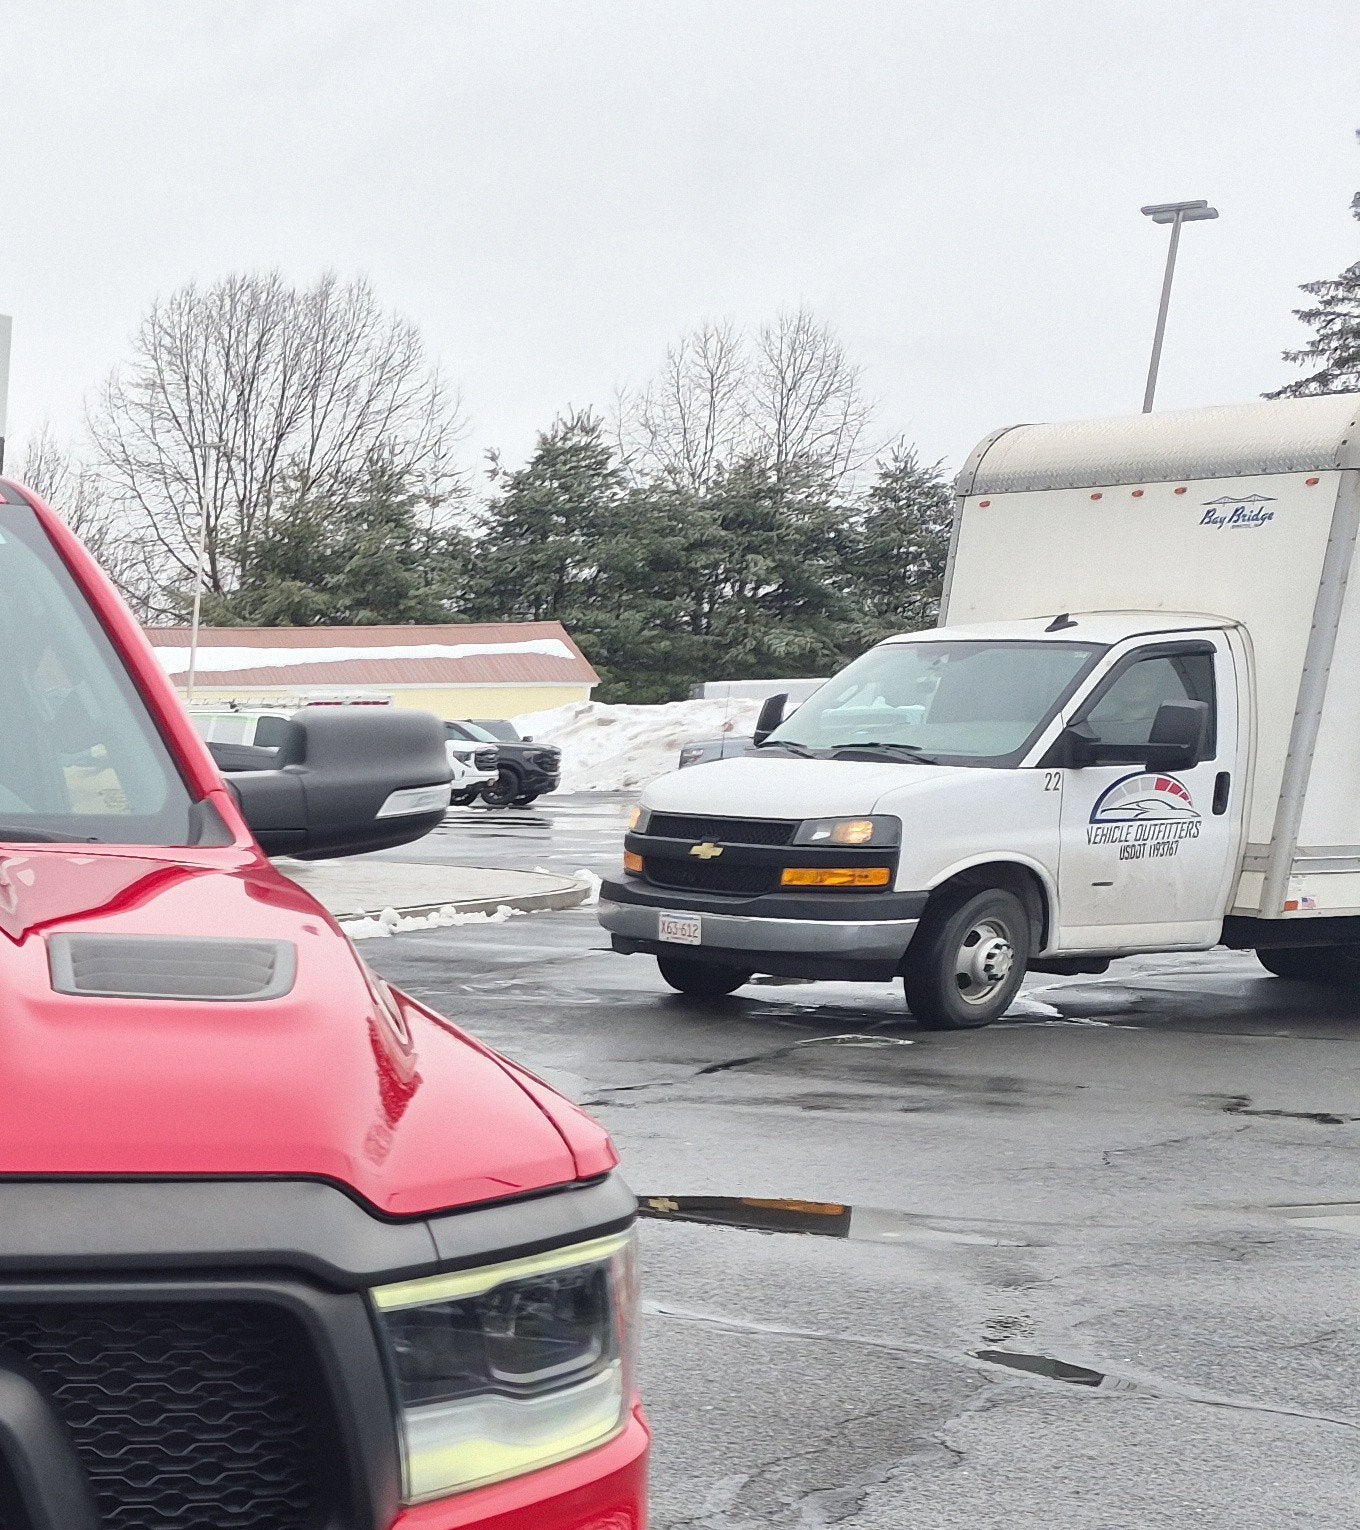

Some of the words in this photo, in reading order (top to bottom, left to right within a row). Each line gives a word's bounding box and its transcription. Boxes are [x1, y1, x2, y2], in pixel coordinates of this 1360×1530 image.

[1199, 507, 1227, 530] Bay
[1227, 505, 1275, 527] Bridge
[1044, 772, 1061, 792] 22
[1086, 826, 1135, 845] VEHICLE
[1134, 820, 1202, 842] OUTFITTERS
